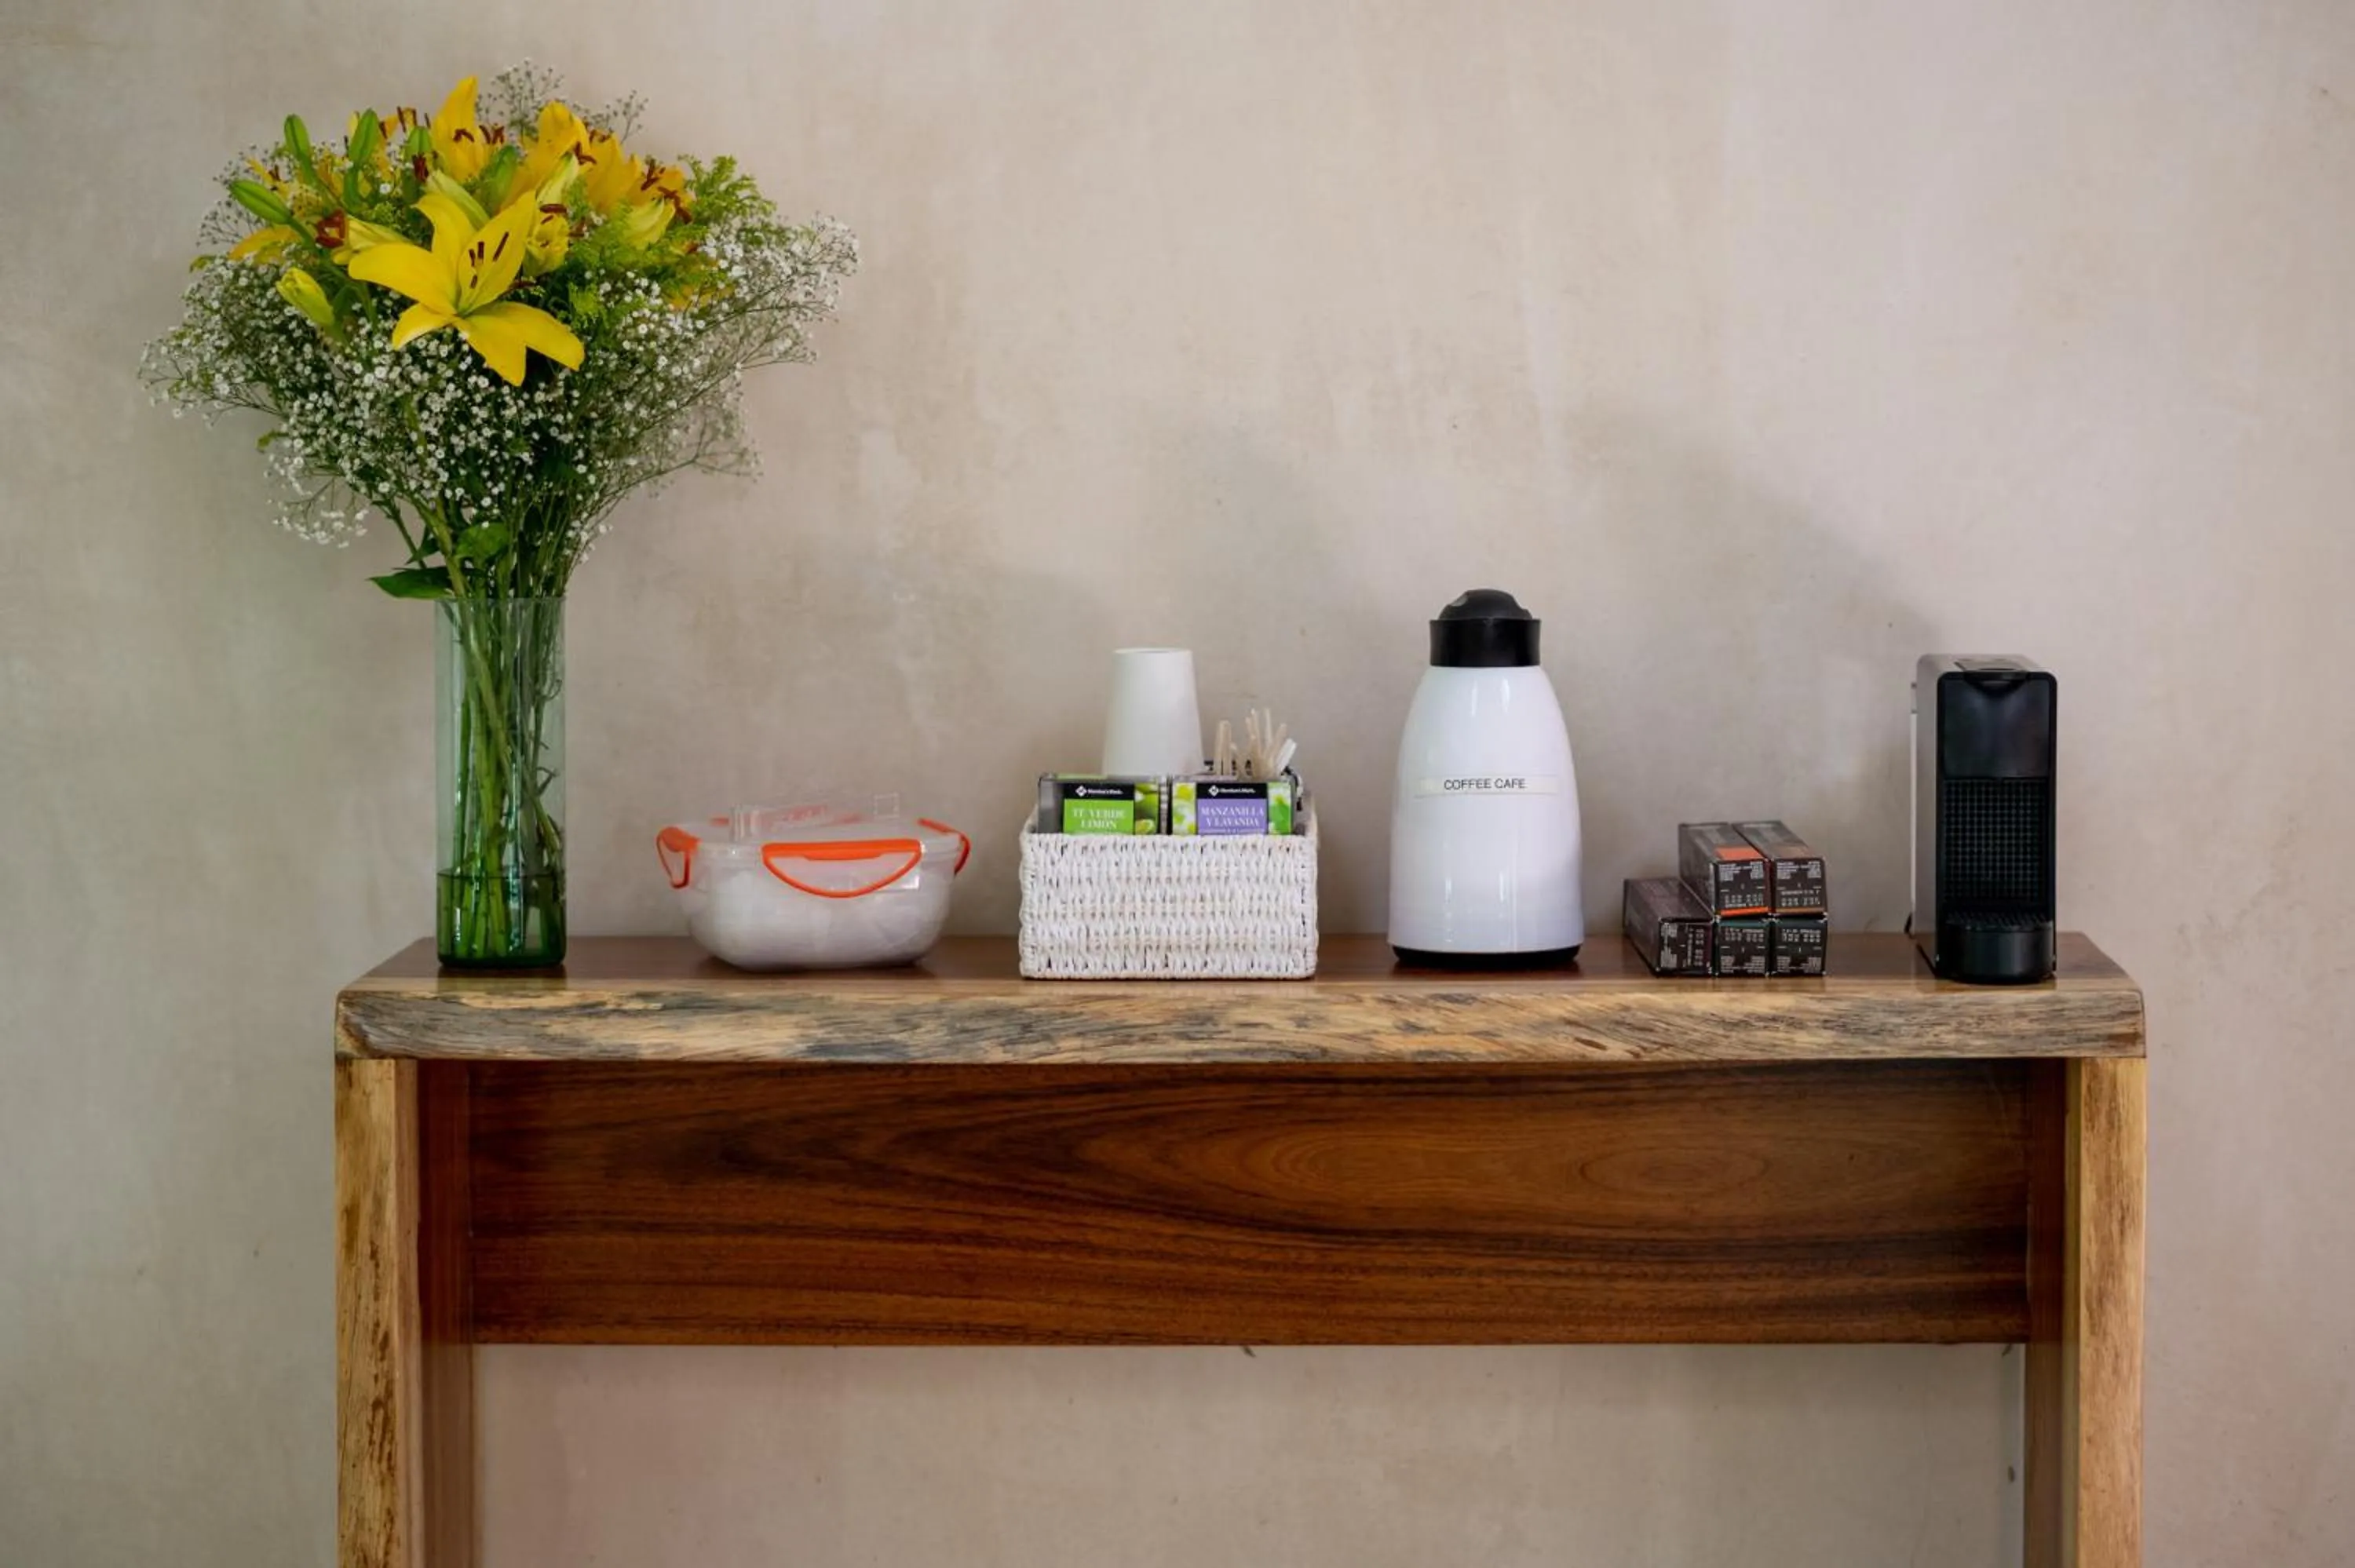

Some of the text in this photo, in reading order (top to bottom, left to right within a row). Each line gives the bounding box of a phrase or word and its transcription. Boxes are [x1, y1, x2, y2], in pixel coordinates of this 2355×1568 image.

[1444, 778, 1528, 790] COFFEE CAFE
[1200, 806, 1264, 815] MANZANILLA
[1214, 817, 1259, 826] LAVANDA
